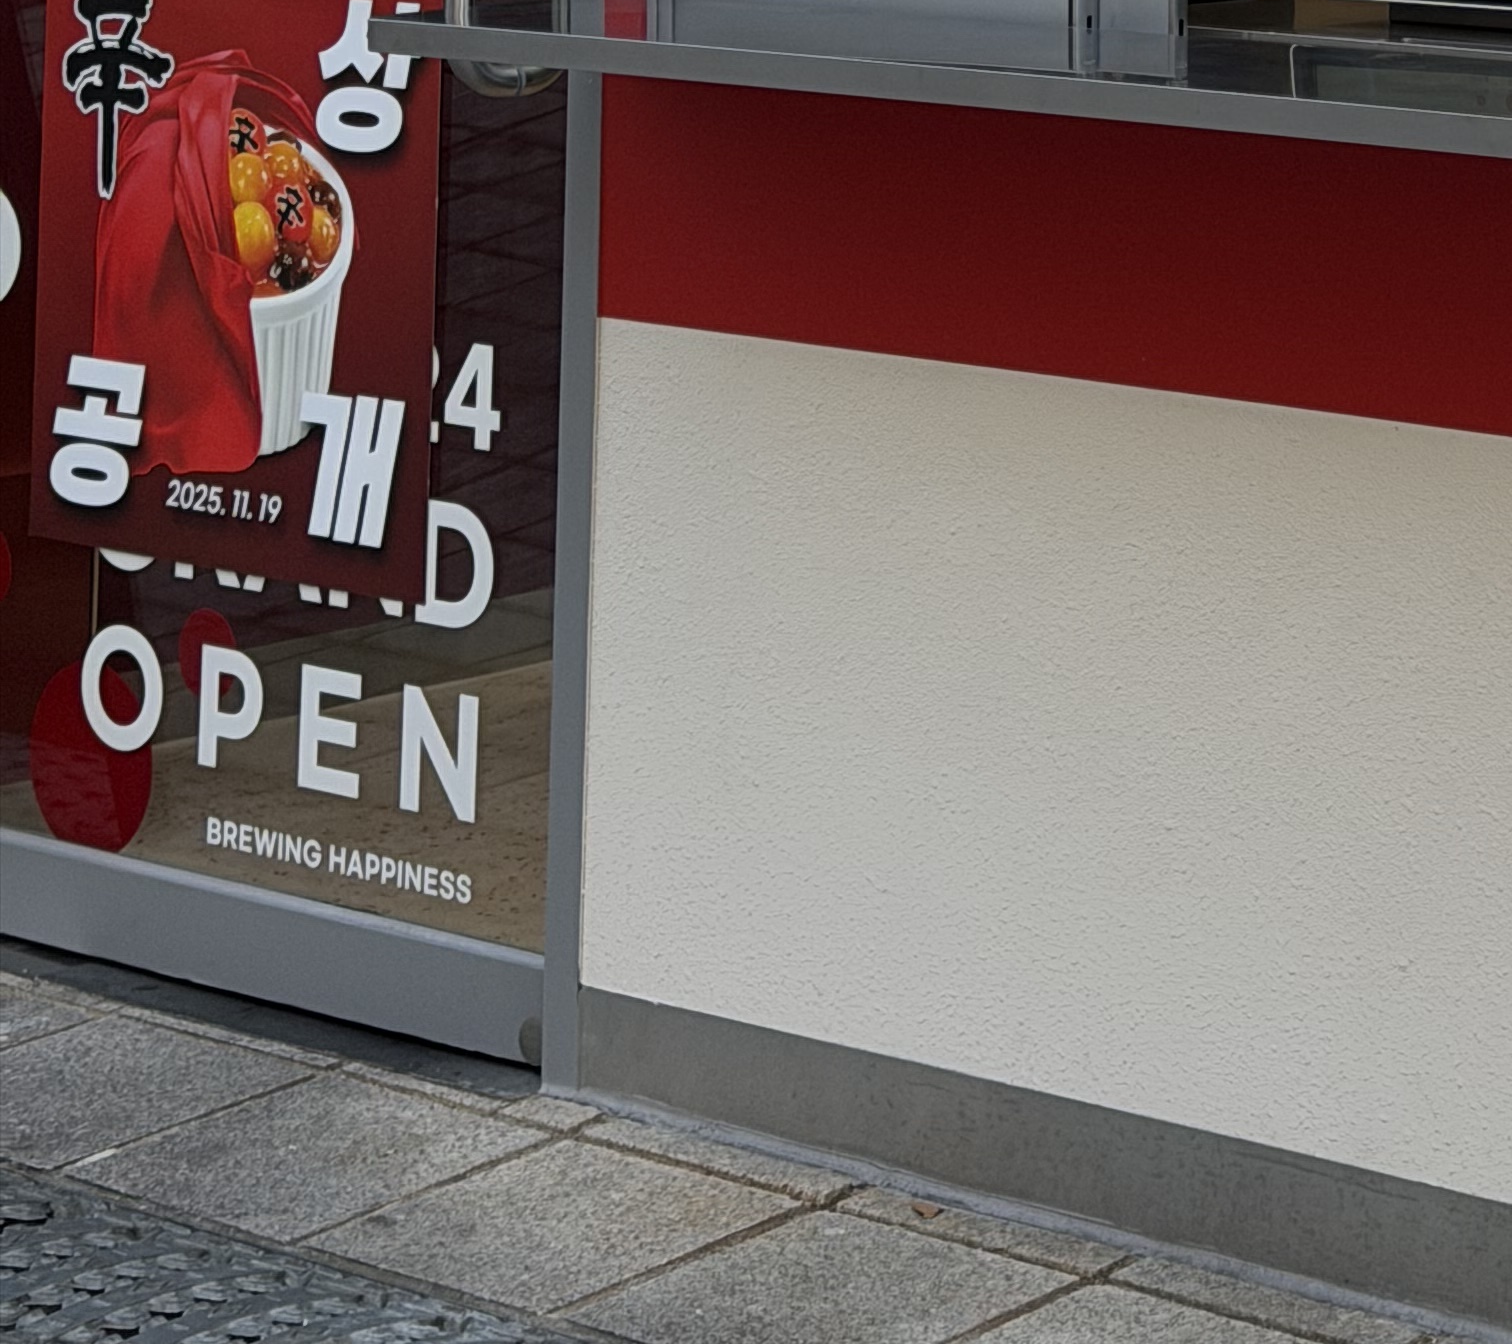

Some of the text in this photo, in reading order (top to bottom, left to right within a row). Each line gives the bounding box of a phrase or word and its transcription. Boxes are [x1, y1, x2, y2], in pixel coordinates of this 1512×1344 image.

[49, 355, 405, 549] 공 개
[81, 624, 480, 823] OPEN
[206, 817, 472, 904] BREWING HAPPINESS
